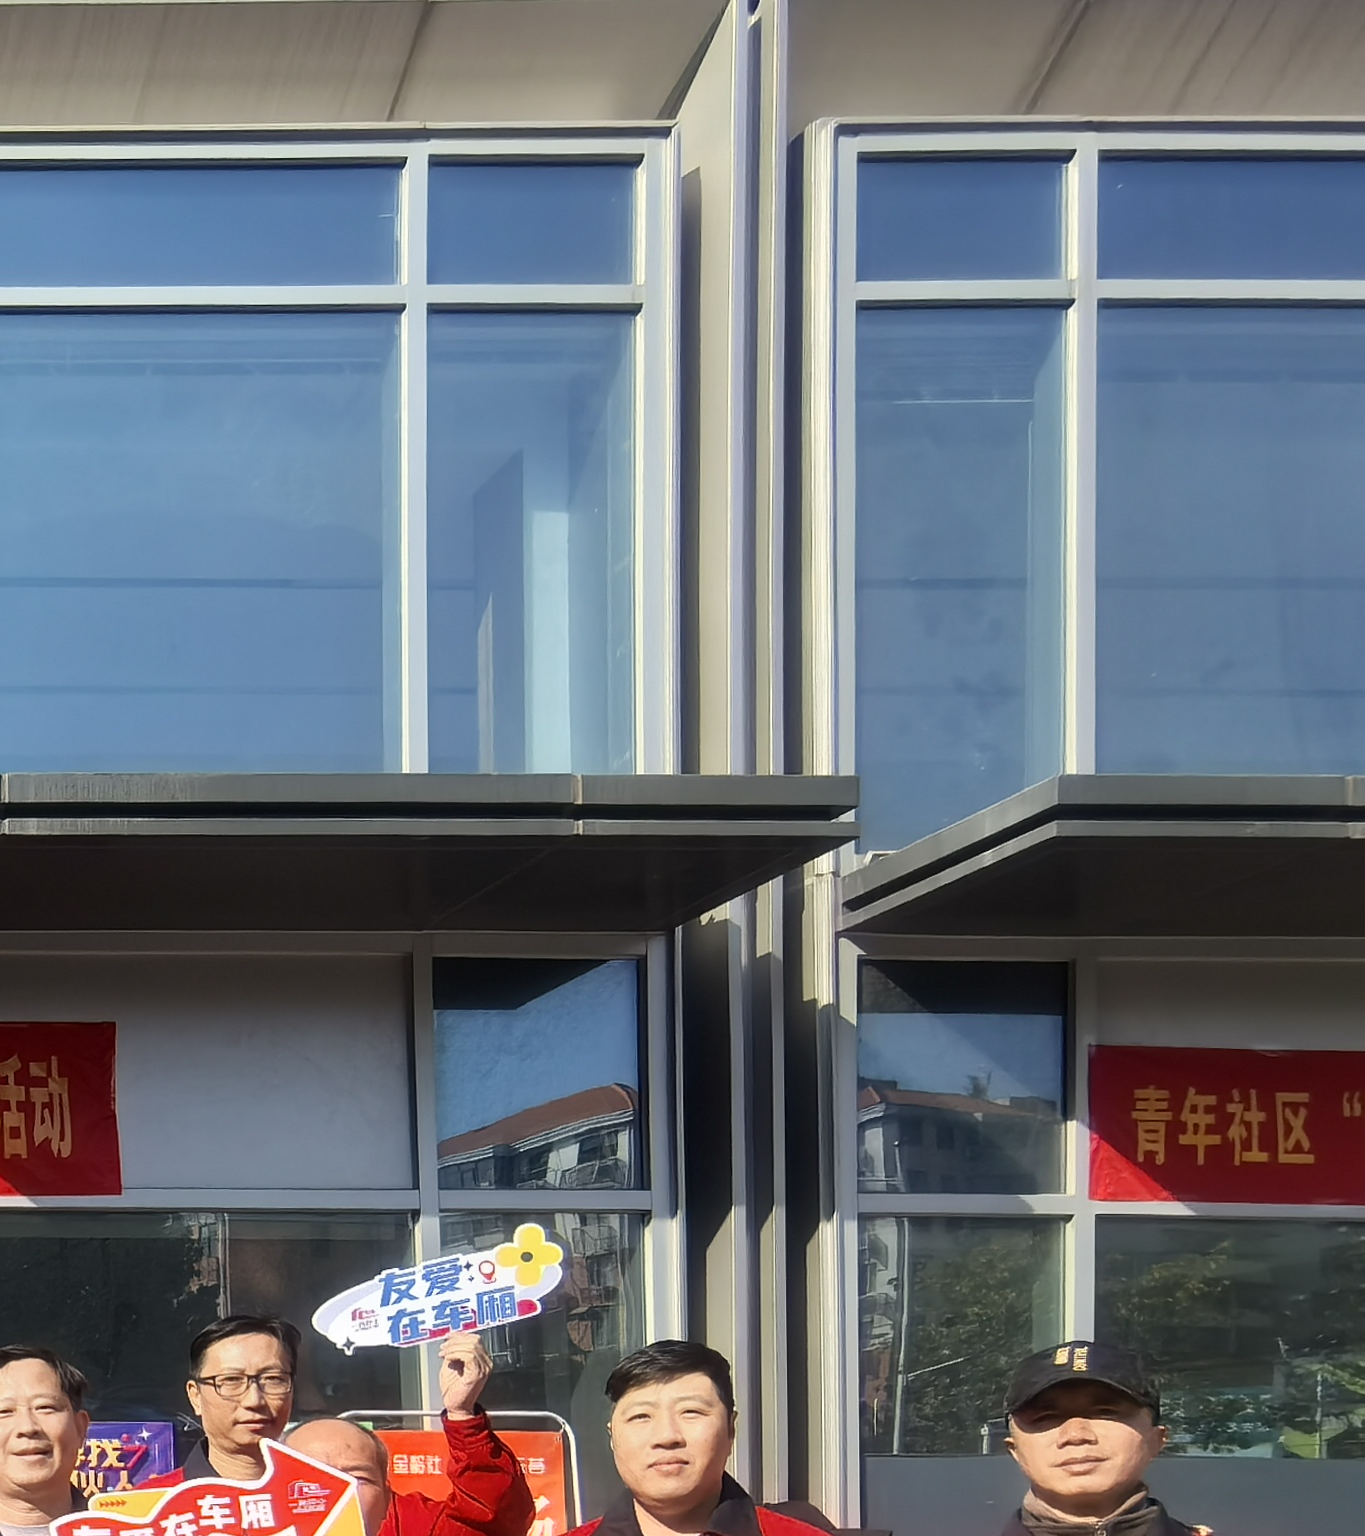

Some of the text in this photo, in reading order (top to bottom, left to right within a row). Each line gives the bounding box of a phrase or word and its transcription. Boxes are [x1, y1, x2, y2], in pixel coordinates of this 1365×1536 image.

[1131, 1085, 1316, 1166] 青年社区
[378, 1257, 463, 1308] 友爱
[387, 1286, 518, 1344] 在车厢
